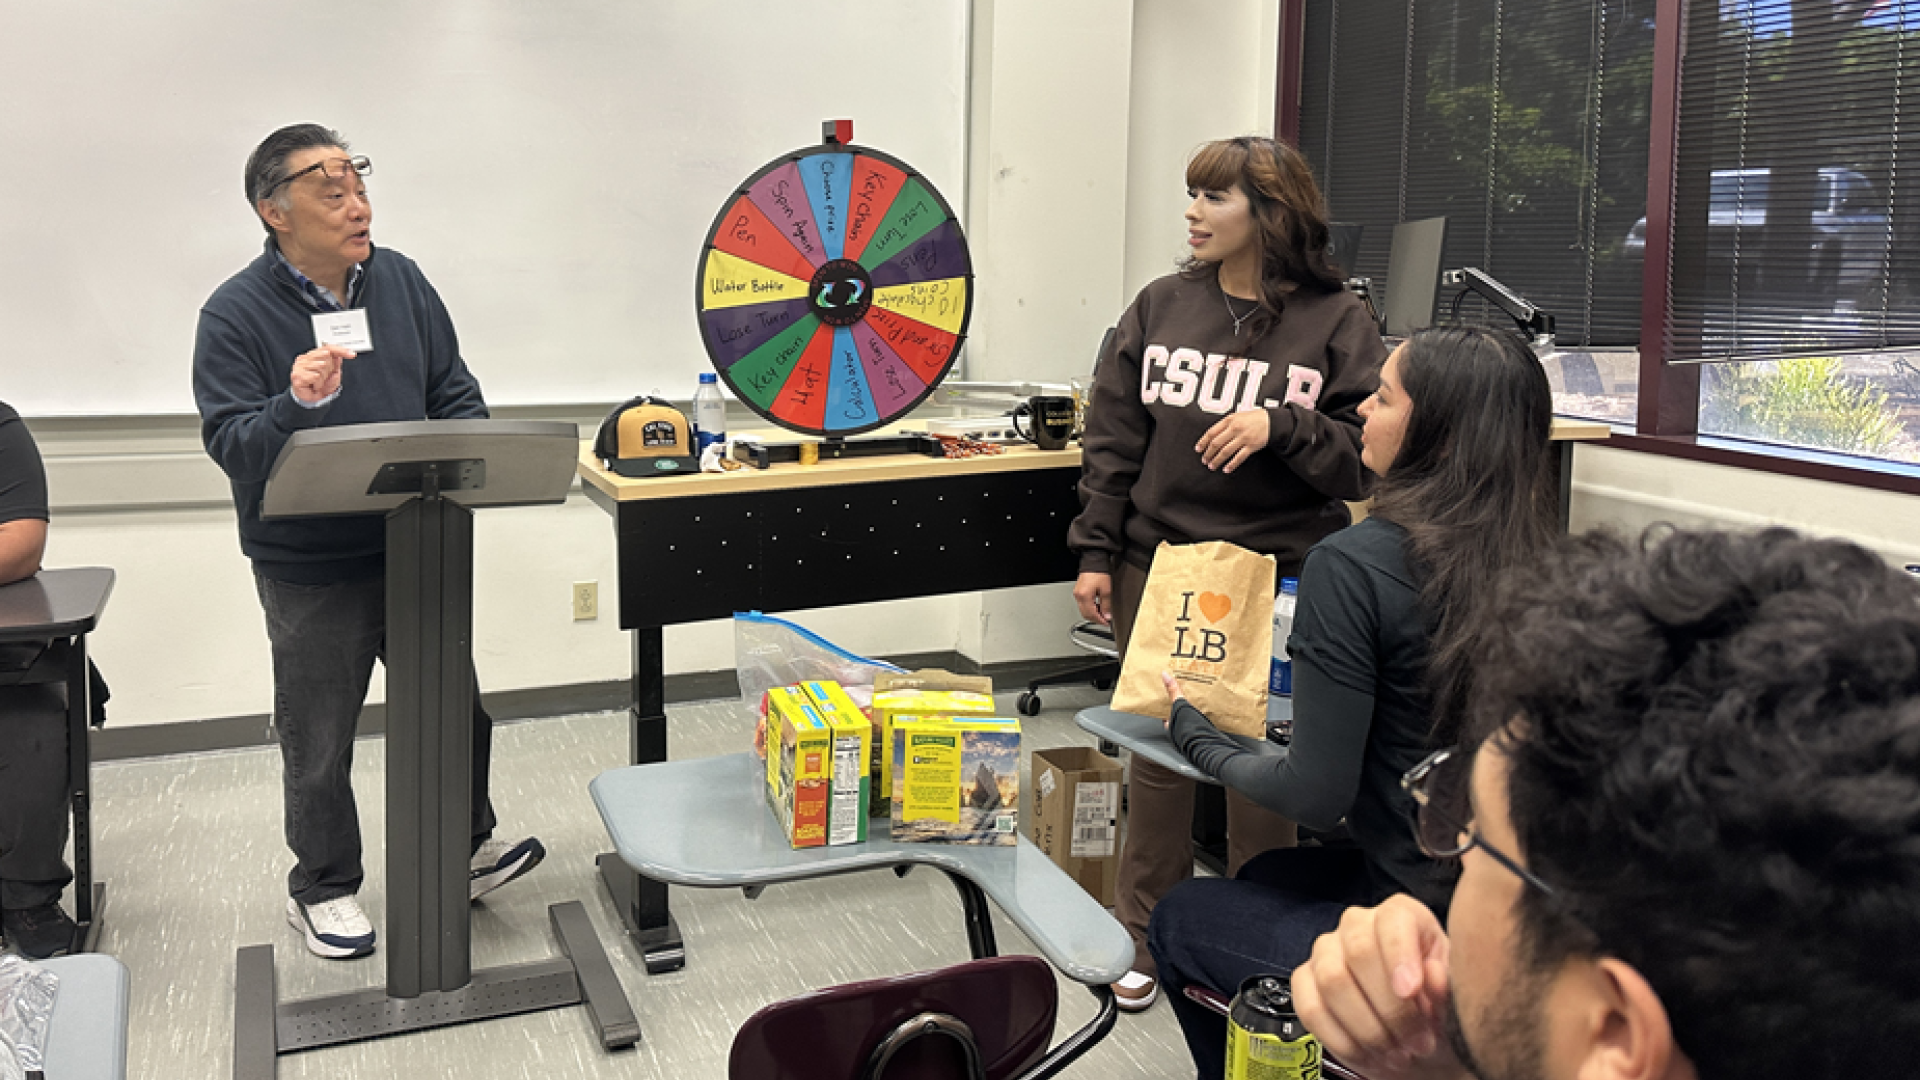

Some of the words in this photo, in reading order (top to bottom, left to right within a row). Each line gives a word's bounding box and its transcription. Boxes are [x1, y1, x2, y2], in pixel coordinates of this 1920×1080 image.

[772, 179, 794, 219] Spin
[900, 201, 930, 227] Lose
[729, 215, 757, 247] Pen
[875, 227, 907, 252] Turn
[900, 239, 938, 273] Pens
[710, 279, 747, 294] Water
[750, 280, 785, 294] Bottle
[939, 294, 959, 316] 10
[717, 323, 752, 345] Lose
[755, 310, 790, 329] Turn
[747, 367, 779, 395] Key
[791, 362, 823, 406] Hat
[1140, 344, 1323, 415] CSULB
[1176, 591, 1195, 621] I
[1170, 626, 1228, 663] LB
